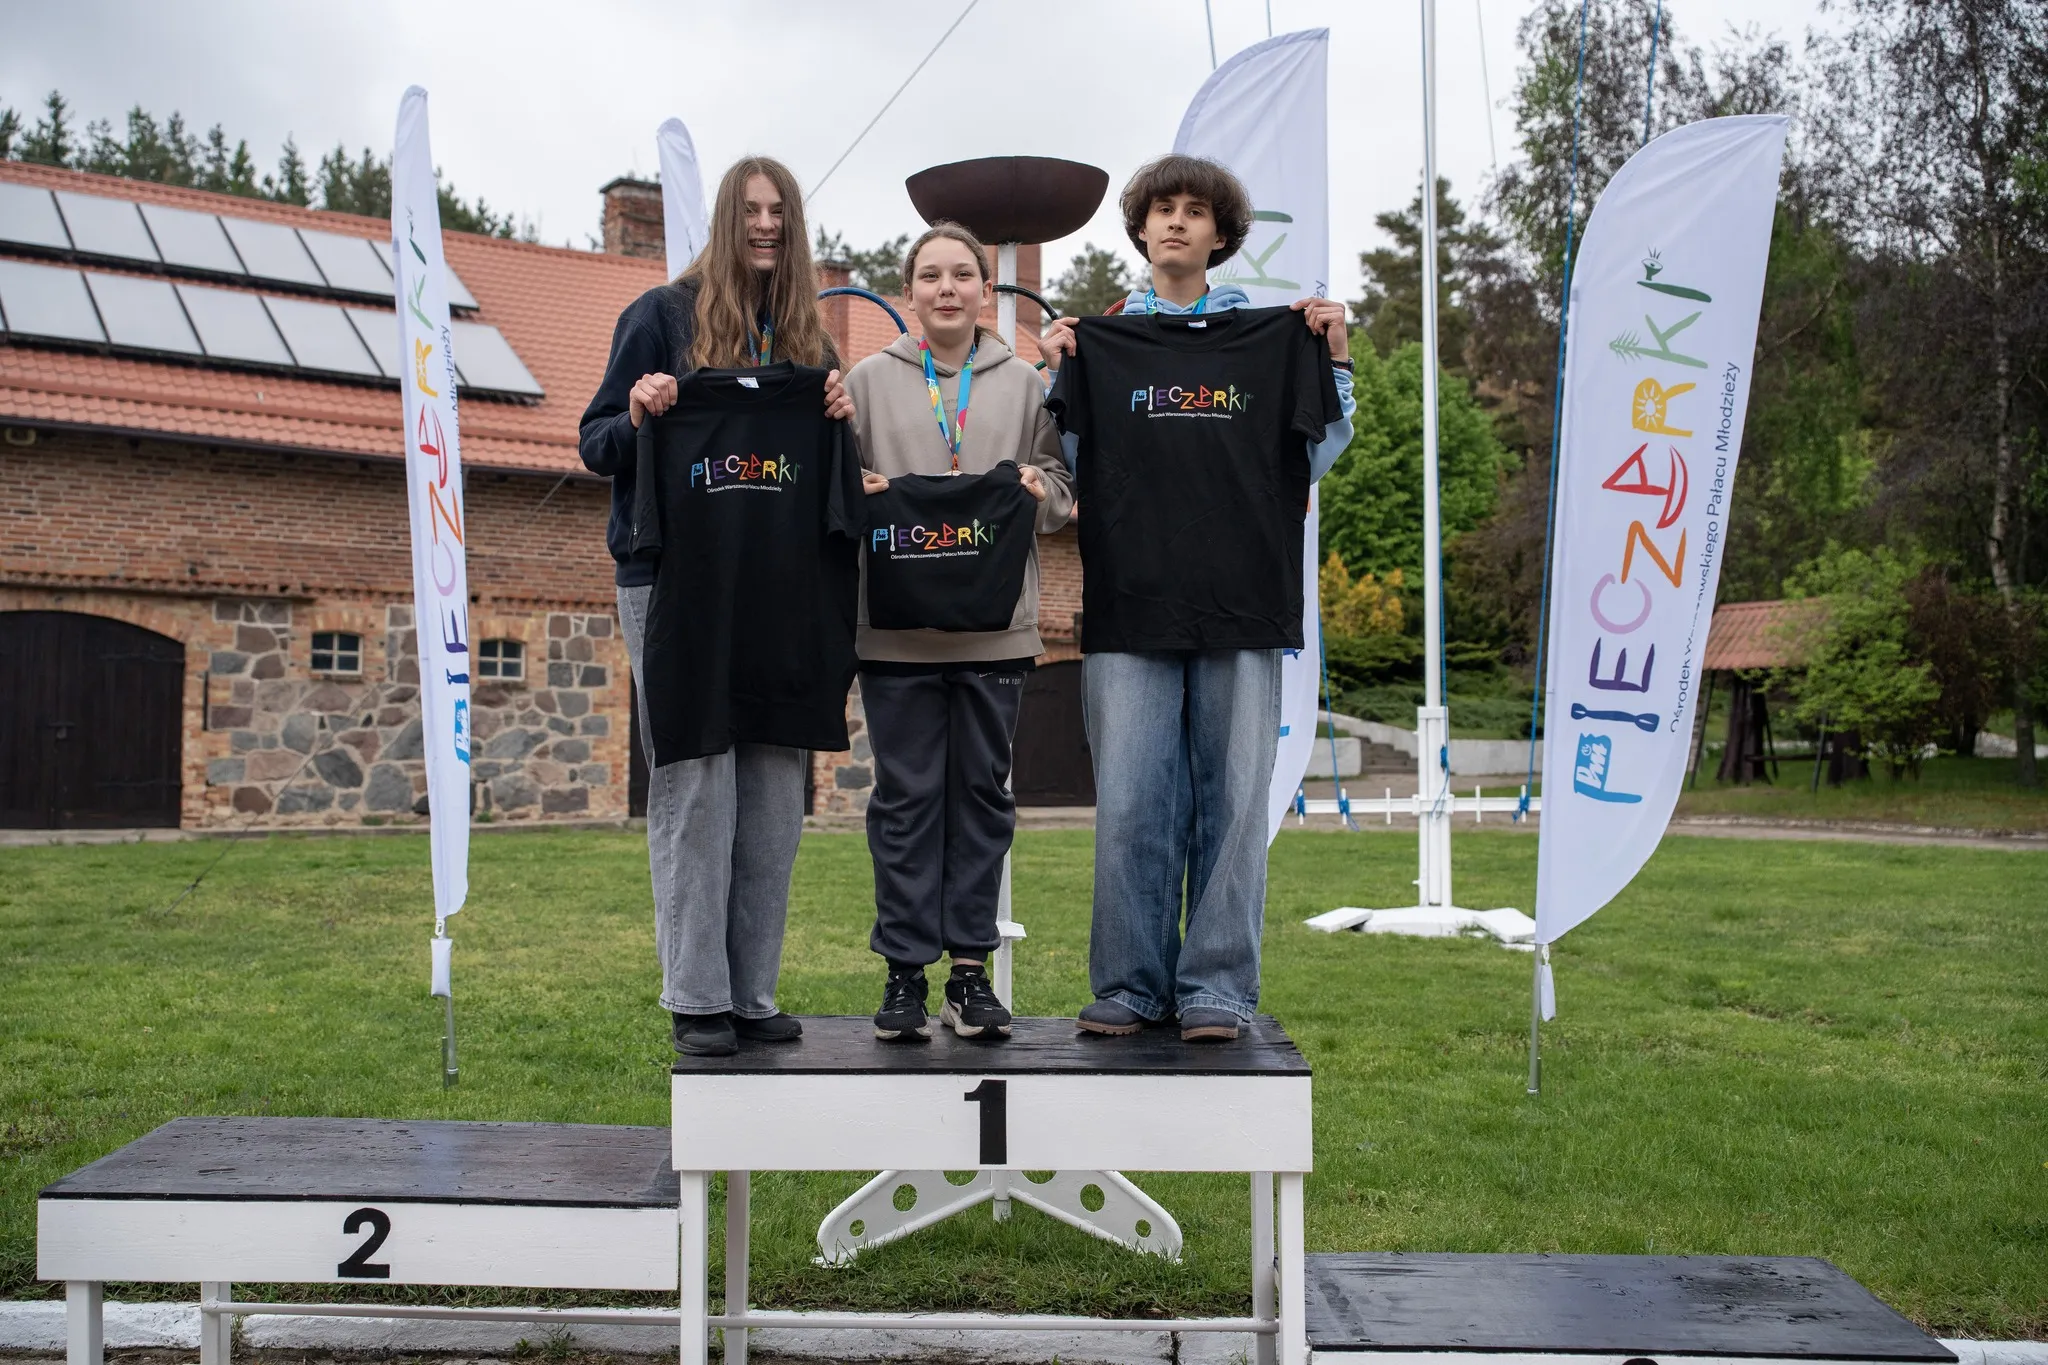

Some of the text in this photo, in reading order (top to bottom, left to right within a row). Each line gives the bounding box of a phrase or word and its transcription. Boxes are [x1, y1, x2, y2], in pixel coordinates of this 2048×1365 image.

[1131, 384, 1254, 413] PIECZARKI
[1714, 361, 1741, 453] Młodzieży
[690, 453, 803, 488] PIECZARKI
[1706, 455, 1728, 516] Pałacu
[872, 518, 998, 553] PIECZARKI
[1571, 247, 1712, 803] PIECZARKI
[964, 1079, 1007, 1165] 1
[337, 1207, 391, 1279] 2
